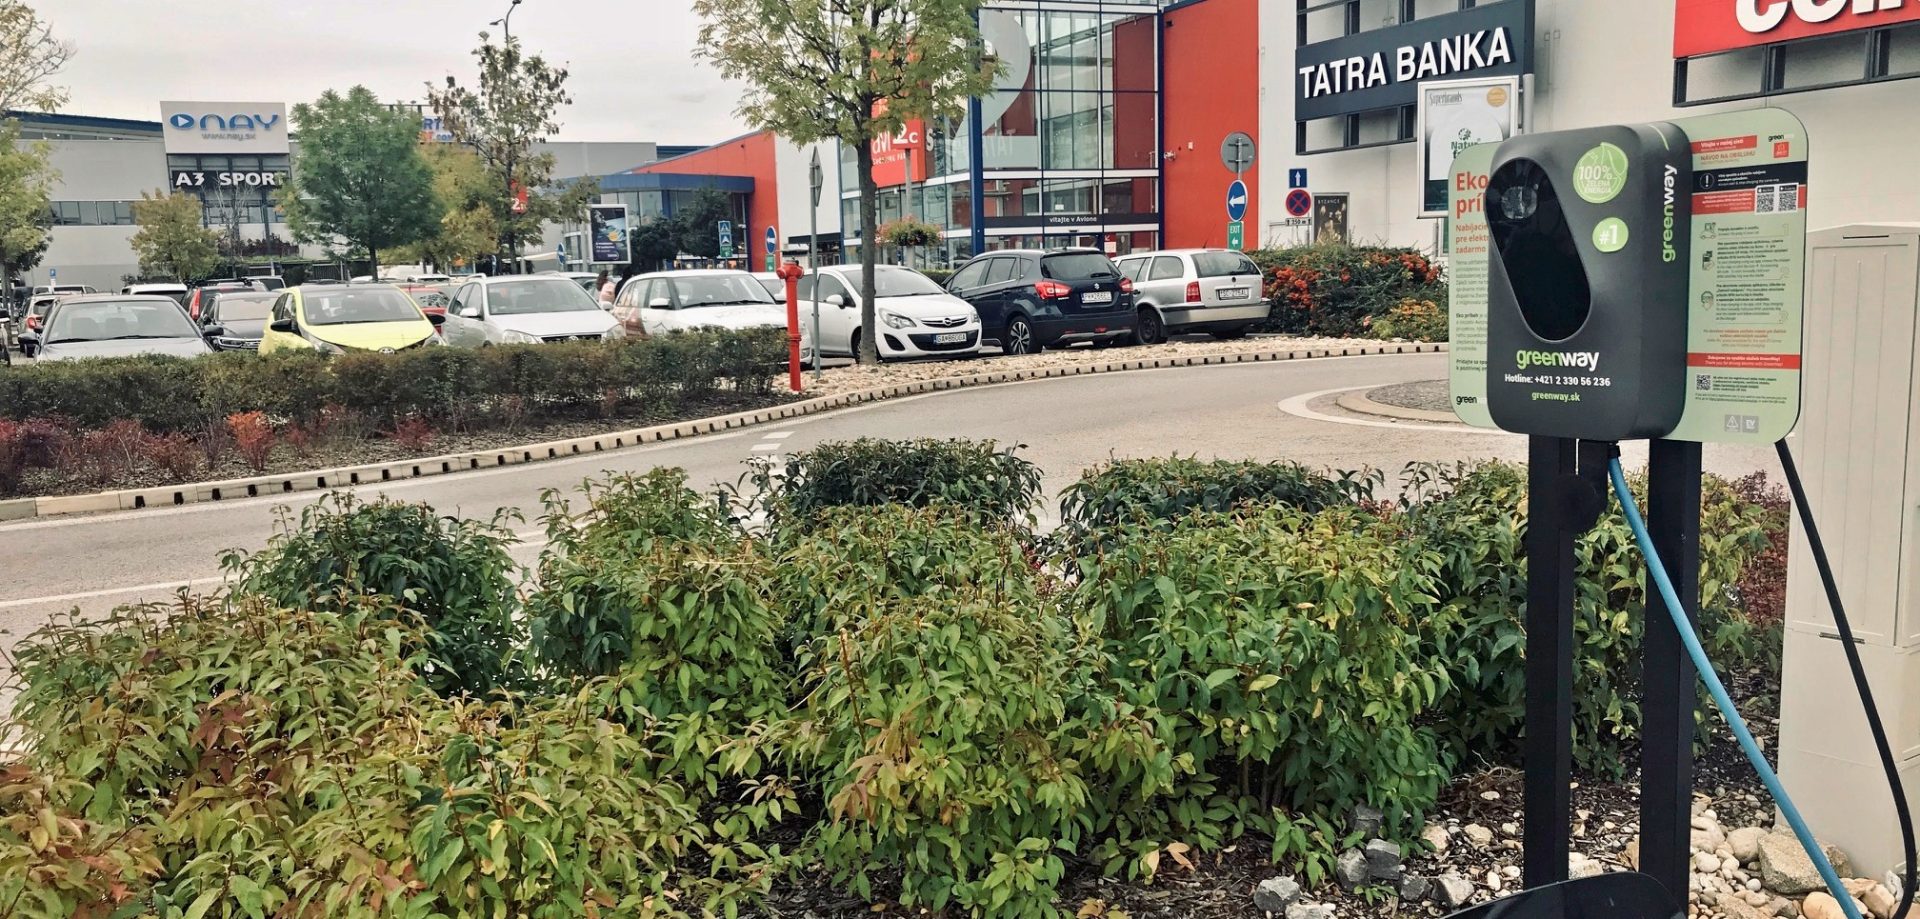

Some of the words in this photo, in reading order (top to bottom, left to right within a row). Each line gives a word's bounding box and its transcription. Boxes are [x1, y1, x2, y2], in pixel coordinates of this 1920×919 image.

[1299, 52, 1388, 99] TATRA
[1396, 27, 1511, 82] BANKA
[176, 172, 205, 186] A3
[218, 172, 286, 186] SPORT
[1579, 165, 1613, 180] 100%
[1456, 172, 1489, 191] Eko
[1049, 216, 1070, 224] vitajte
[1662, 164, 1677, 262] greenway
[1230, 225, 1240, 233] EXIT
[1599, 224, 1618, 245] #1
[1456, 236, 1468, 245] pre
[1456, 246, 1486, 254] zadarmo
[1516, 349, 1600, 372] greenway
[1504, 373, 1533, 383] Hotline:
[1535, 375, 1553, 384] +421
[1555, 376, 1561, 385] 2
[1563, 376, 1579, 385] 330
[1581, 377, 1592, 386] 56
[1593, 377, 1611, 386] 236
[1532, 391, 1580, 402] greenway.sk
